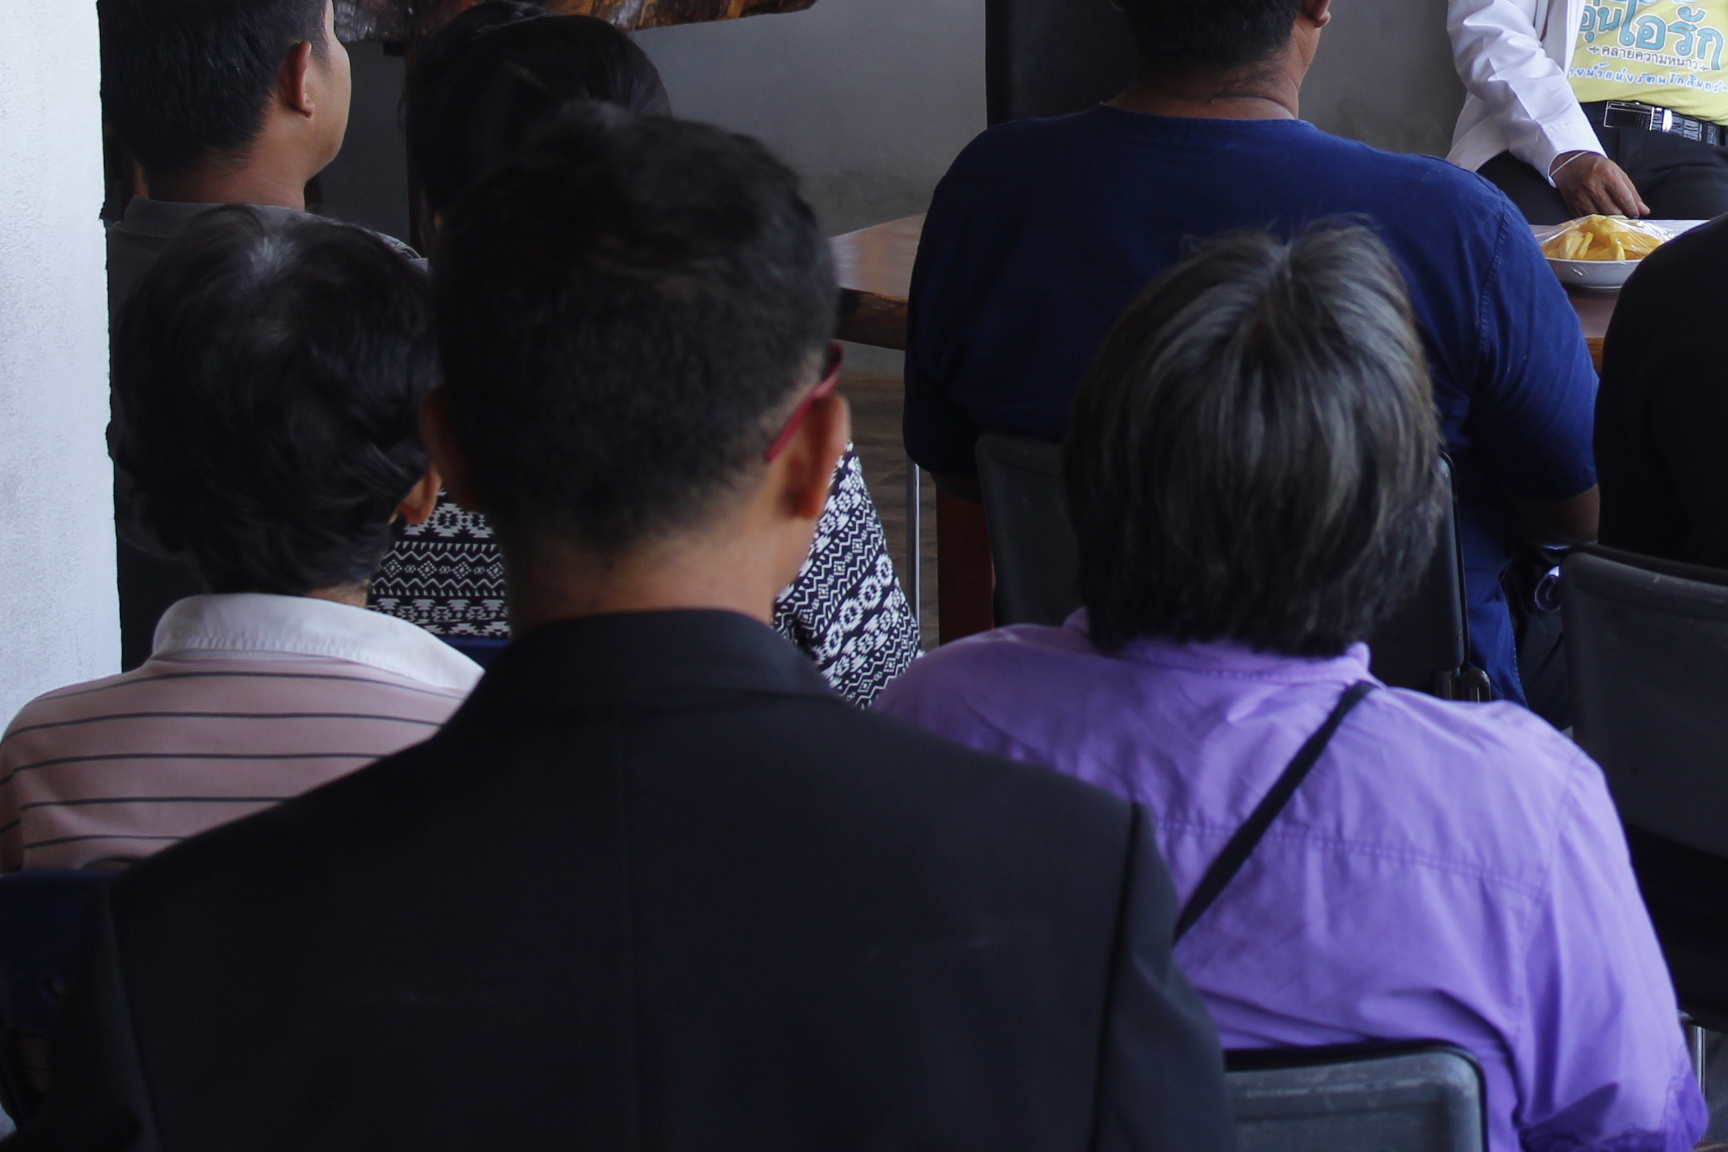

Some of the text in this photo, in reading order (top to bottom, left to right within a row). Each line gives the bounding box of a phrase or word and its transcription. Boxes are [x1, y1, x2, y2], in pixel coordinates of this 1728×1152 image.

[1601, 46, 1698, 70] คลายความหนาว
